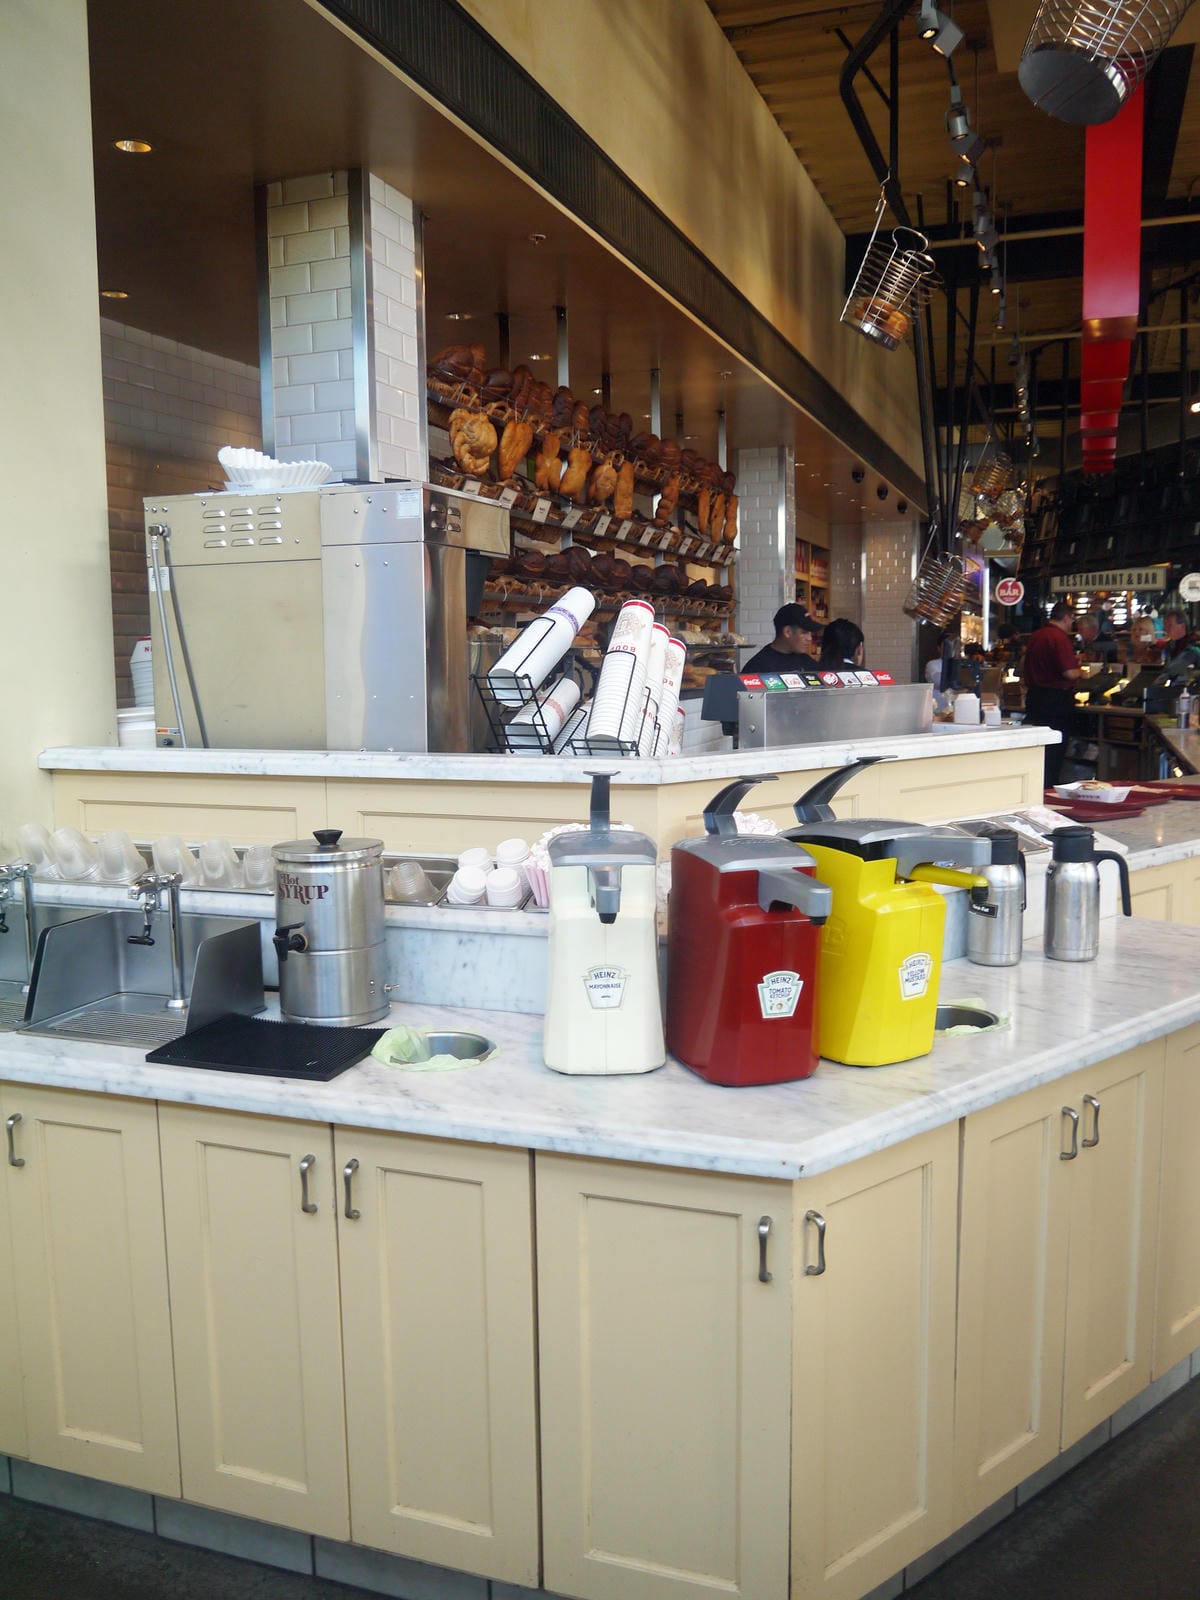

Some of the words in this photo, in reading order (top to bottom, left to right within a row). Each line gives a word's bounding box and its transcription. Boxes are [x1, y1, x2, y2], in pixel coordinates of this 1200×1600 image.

[1059, 573, 1124, 587] RESTAURANT
[1127, 573, 1134, 585] &
[1137, 572, 1158, 585] BAR
[999, 588, 1020, 596] BAR
[281, 873, 300, 885] Hot
[278, 884, 329, 905] SYRUP
[593, 971, 617, 980] HEINZ
[770, 976, 792, 985] HEINZ
